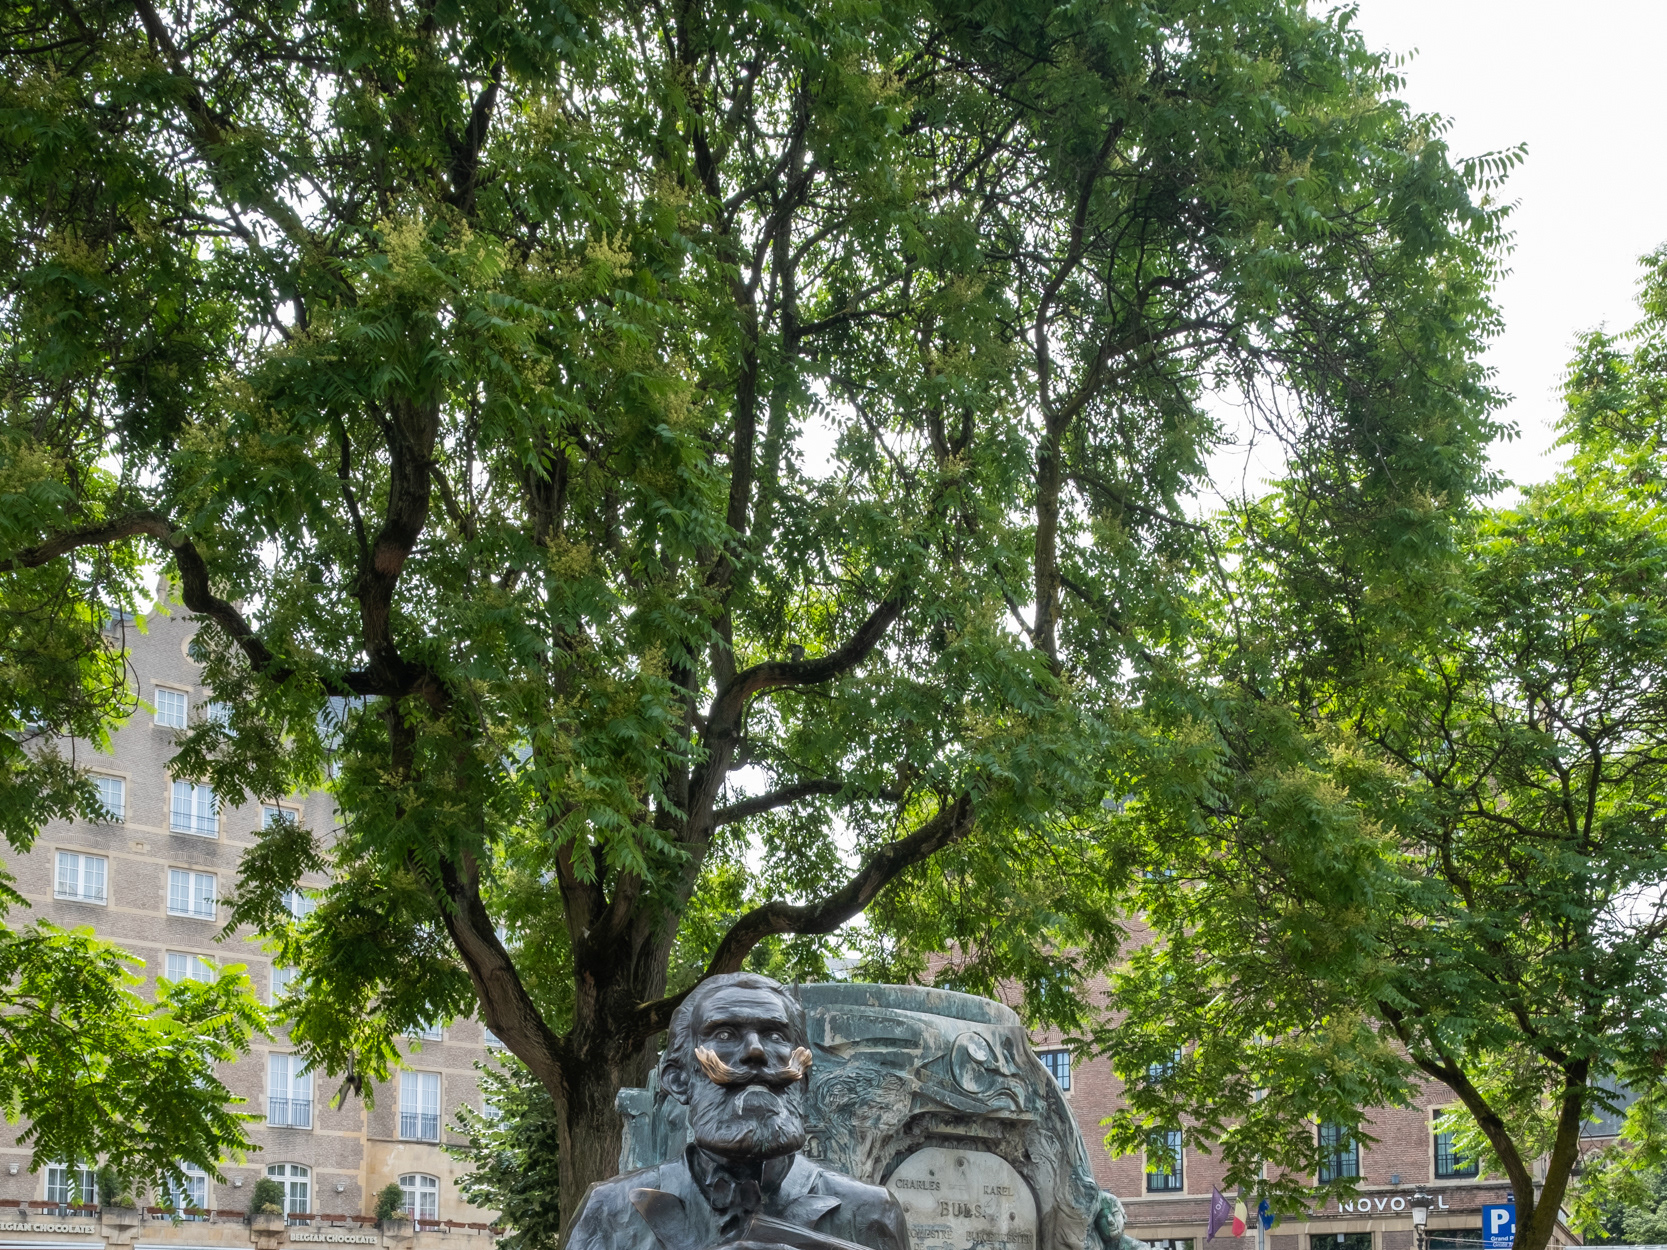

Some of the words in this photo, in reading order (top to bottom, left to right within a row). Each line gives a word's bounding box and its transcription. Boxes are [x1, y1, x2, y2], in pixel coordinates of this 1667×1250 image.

[895, 1179, 941, 1191] CHARLES
[983, 1185, 1014, 1196] KAREL
[1338, 1195, 1449, 1212] NOVOL
[33, 1224, 95, 1234] CHOCOLATES
[290, 1233, 326, 1242] BELGIAN
[326, 1235, 378, 1244] CHOCOLATES
